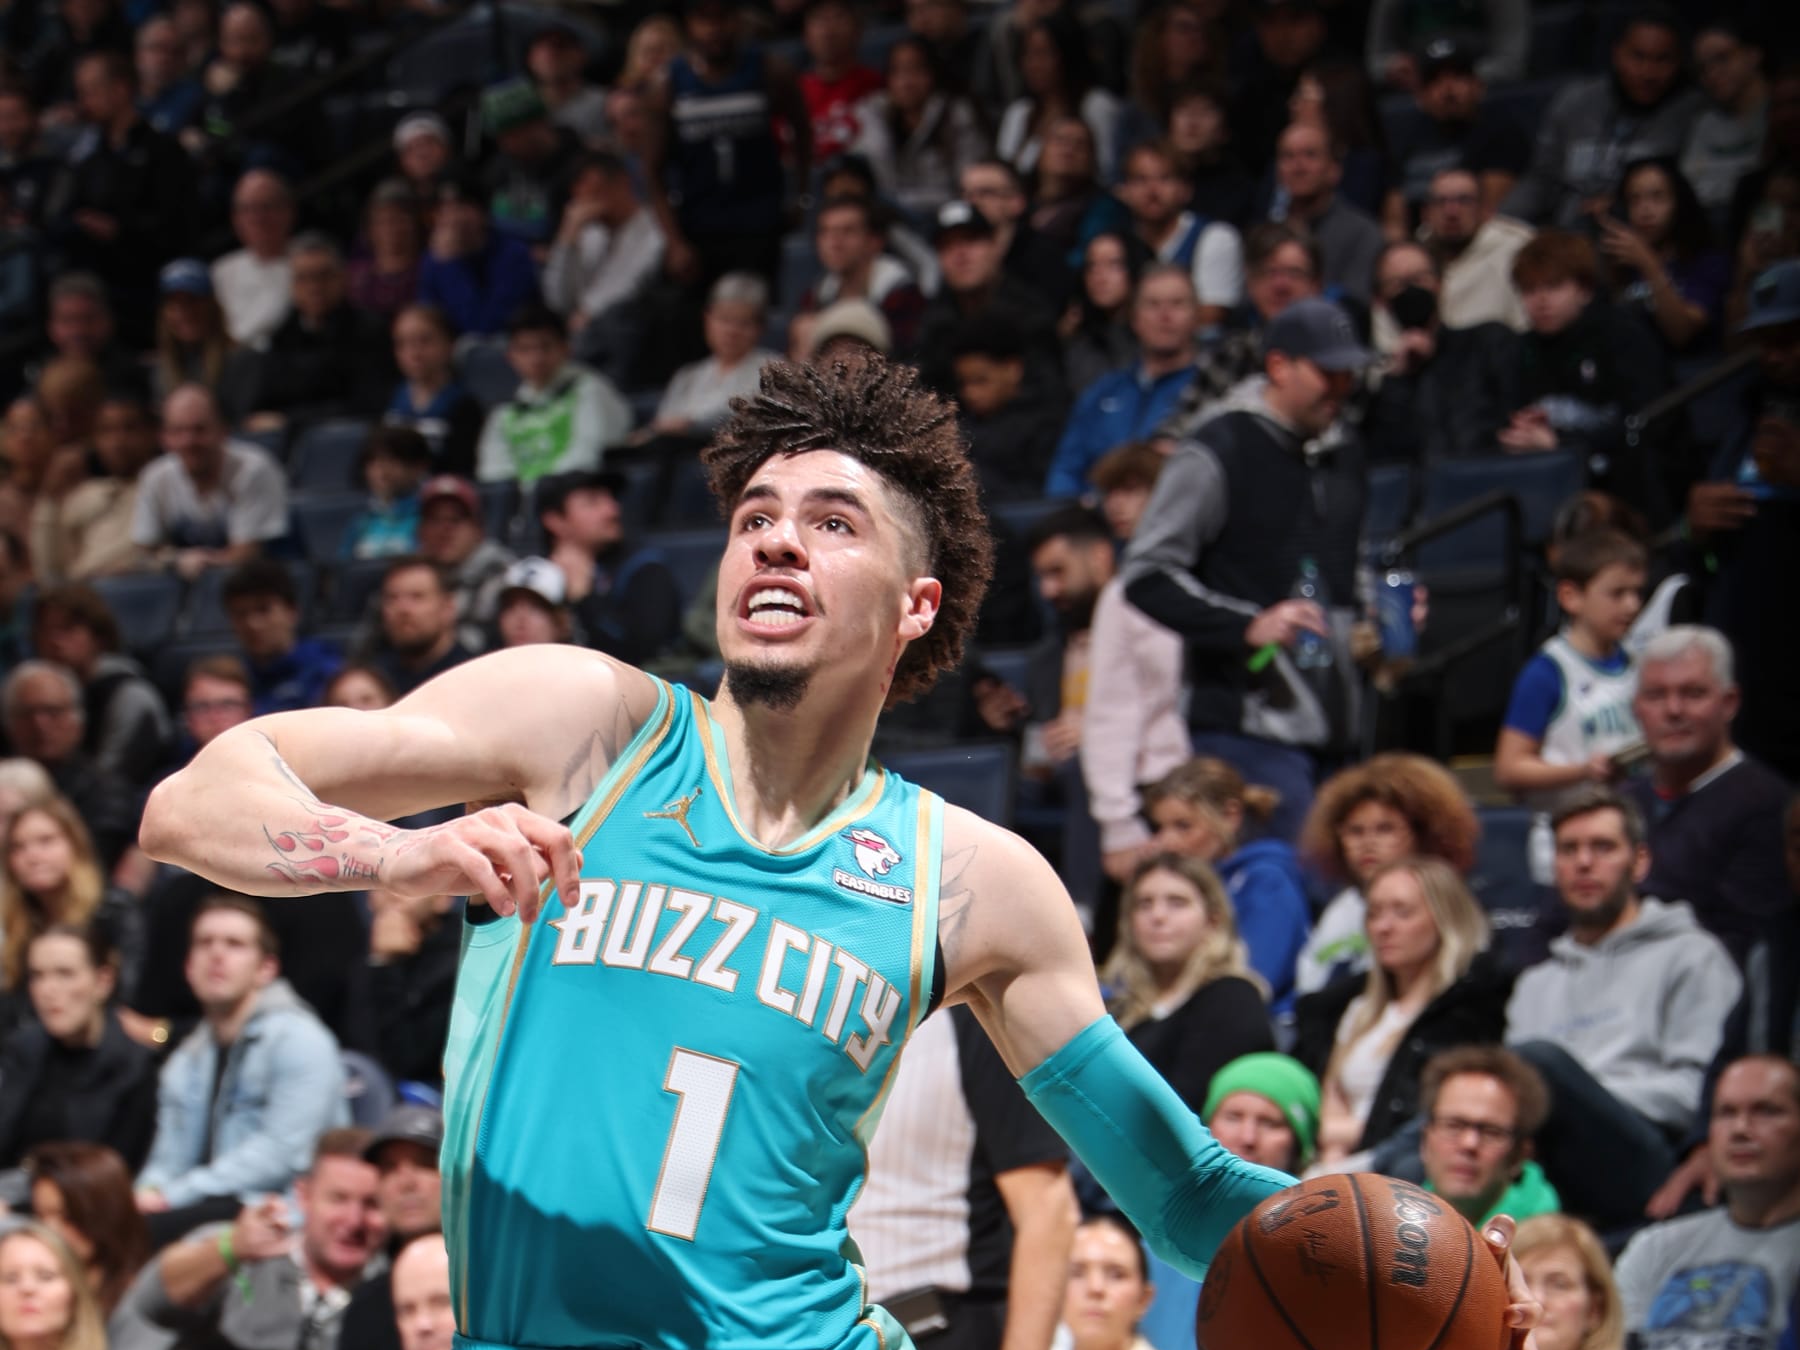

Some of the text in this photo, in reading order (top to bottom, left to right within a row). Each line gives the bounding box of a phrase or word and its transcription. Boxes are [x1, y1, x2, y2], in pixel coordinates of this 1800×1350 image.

[547, 878, 903, 1074] BUZZ CITY
[835, 869, 912, 904] FEASTABLES
[645, 1045, 740, 1243] 1
